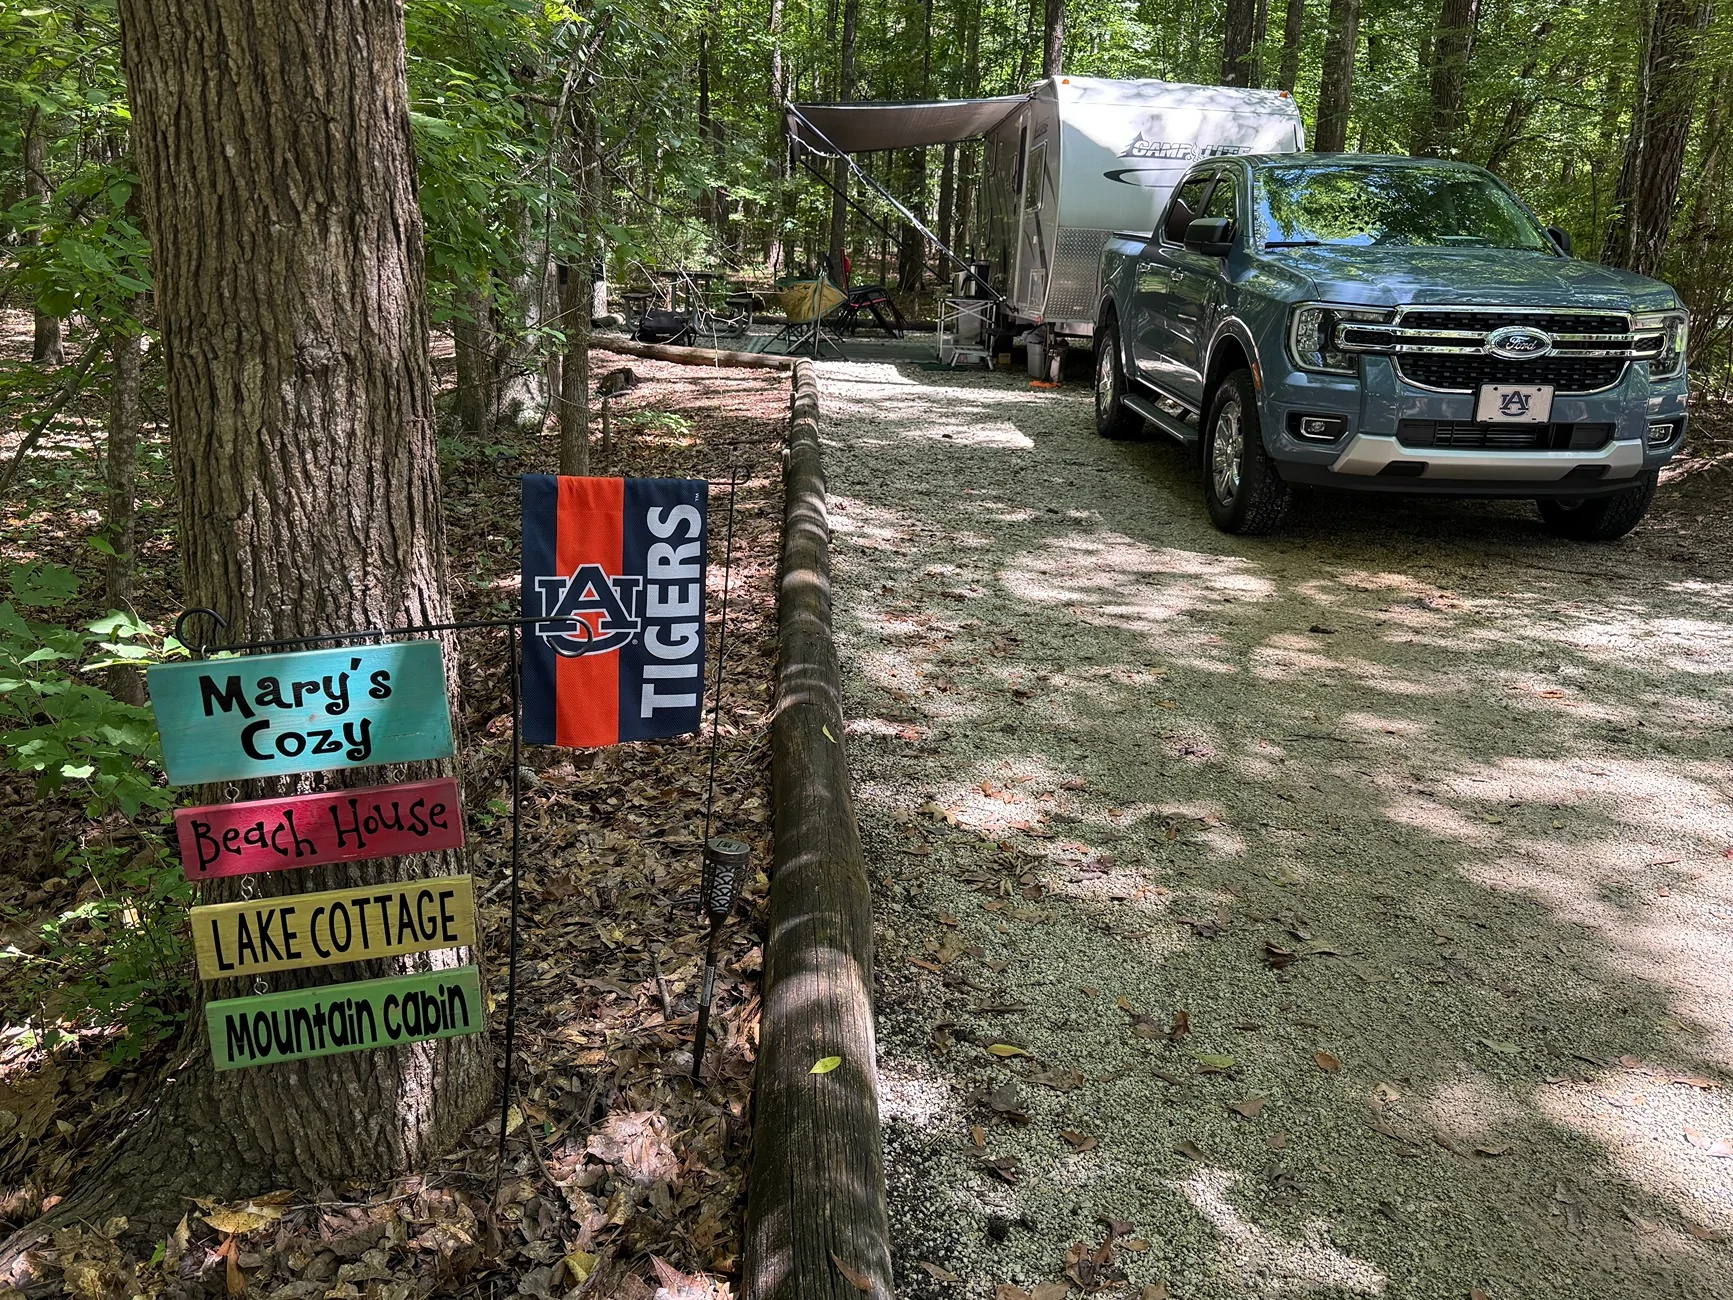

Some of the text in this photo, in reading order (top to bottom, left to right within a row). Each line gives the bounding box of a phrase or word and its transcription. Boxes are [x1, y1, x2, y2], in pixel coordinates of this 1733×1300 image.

[1131, 139, 1193, 159] CAMP
[1505, 335, 1537, 351] Ford
[640, 503, 702, 718] TIGERS
[199, 657, 393, 719] Mary's
[240, 717, 372, 761] Cozy
[190, 798, 449, 872] Beach House
[211, 889, 458, 971] LAKE COTTAGE
[225, 983, 470, 1062] Mountain cabin
